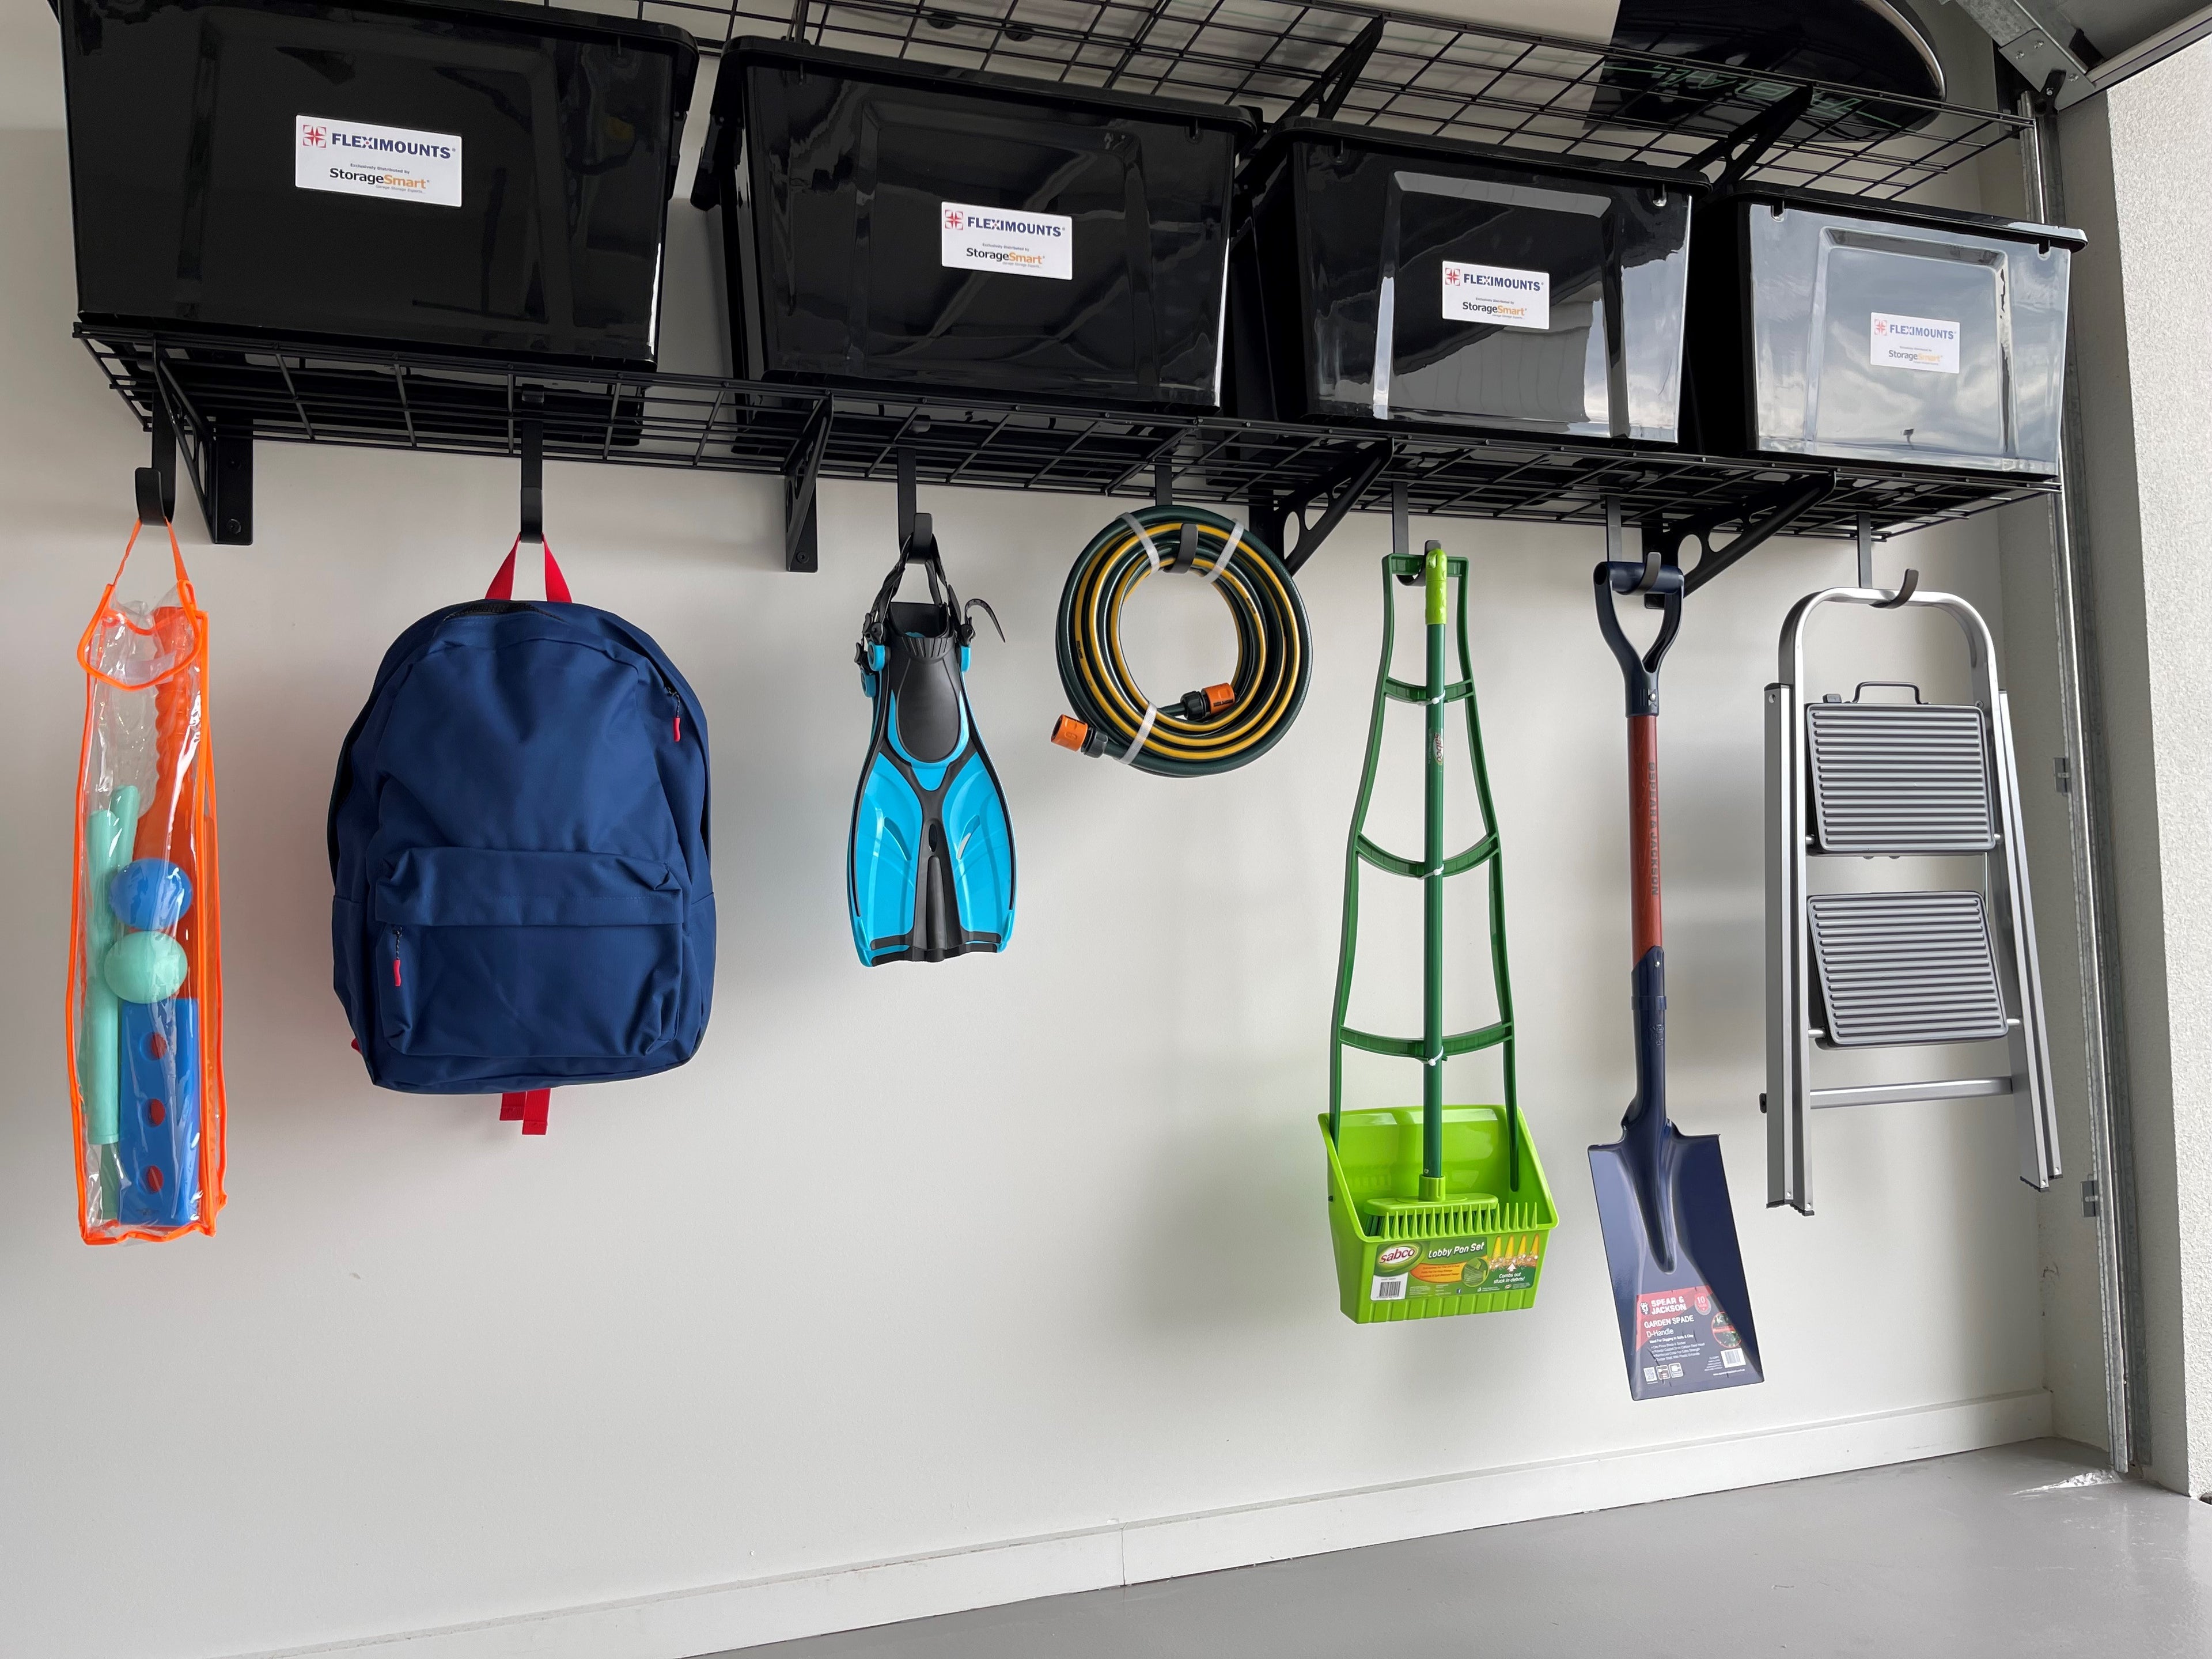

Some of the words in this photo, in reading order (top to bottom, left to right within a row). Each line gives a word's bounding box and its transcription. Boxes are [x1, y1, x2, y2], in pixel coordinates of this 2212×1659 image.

[332, 132, 451, 159] FLEXIMOUNTS
[330, 168, 426, 189] StorageSmart
[968, 217, 1062, 237] FLEXIMOUNTS
[966, 248, 1043, 264] StorageSmart
[1464, 274, 1540, 291] FLEXIMOUNTS
[1463, 301, 1525, 316] StorageSmart
[1889, 324, 1954, 340] FLEXIMOUNTS
[1379, 1248, 1415, 1264] sabco
[1428, 1247, 1452, 1258] Lobby
[1453, 1245, 1469, 1255] Pan
[1470, 1241, 1484, 1252] Set
[1650, 1297, 1677, 1308] SPEAR
[1696, 1296, 1706, 1304] 10
[1651, 1303, 1687, 1315] JACKSON
[1643, 1318, 1671, 1328] GARDEN
[1672, 1315, 1695, 1324] SPADE
[1646, 1328, 1674, 1338] D-Handle
